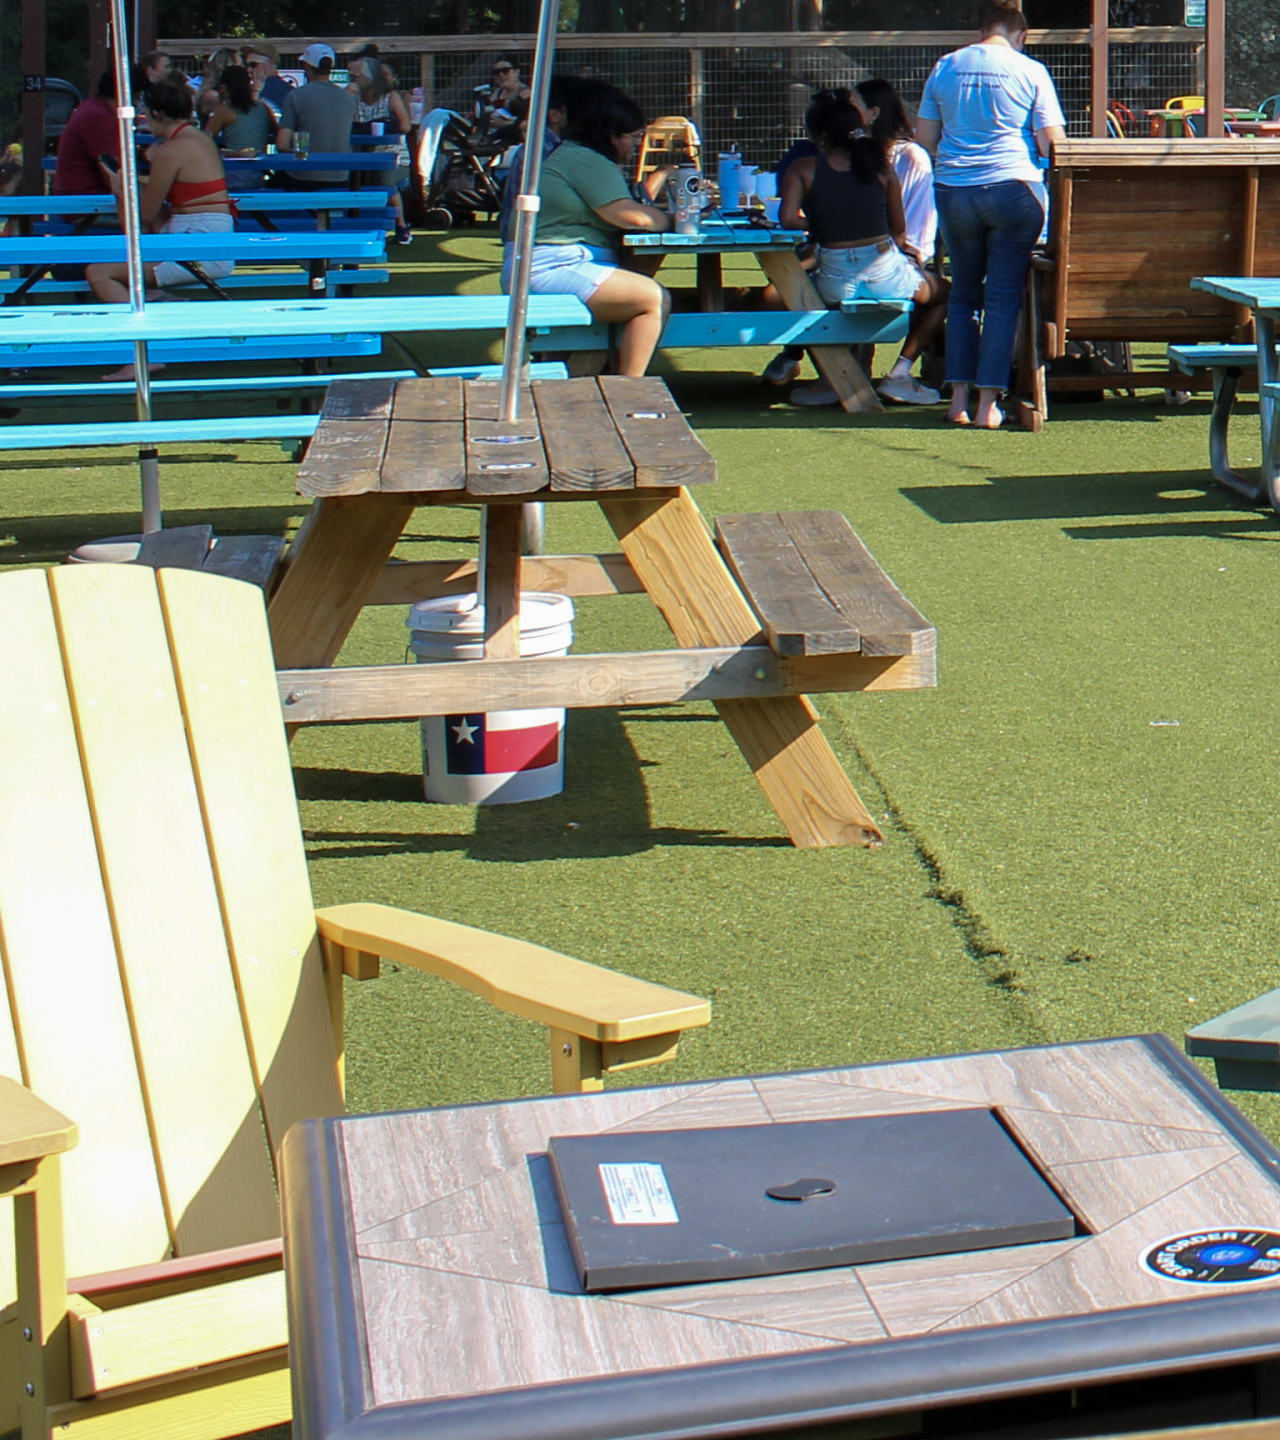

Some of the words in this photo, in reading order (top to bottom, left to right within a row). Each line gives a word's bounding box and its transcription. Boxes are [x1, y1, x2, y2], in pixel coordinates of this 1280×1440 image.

[26, 76, 41, 90] 34
[1165, 1231, 1239, 1253] ORDER
[1155, 1250, 1195, 1277] START
